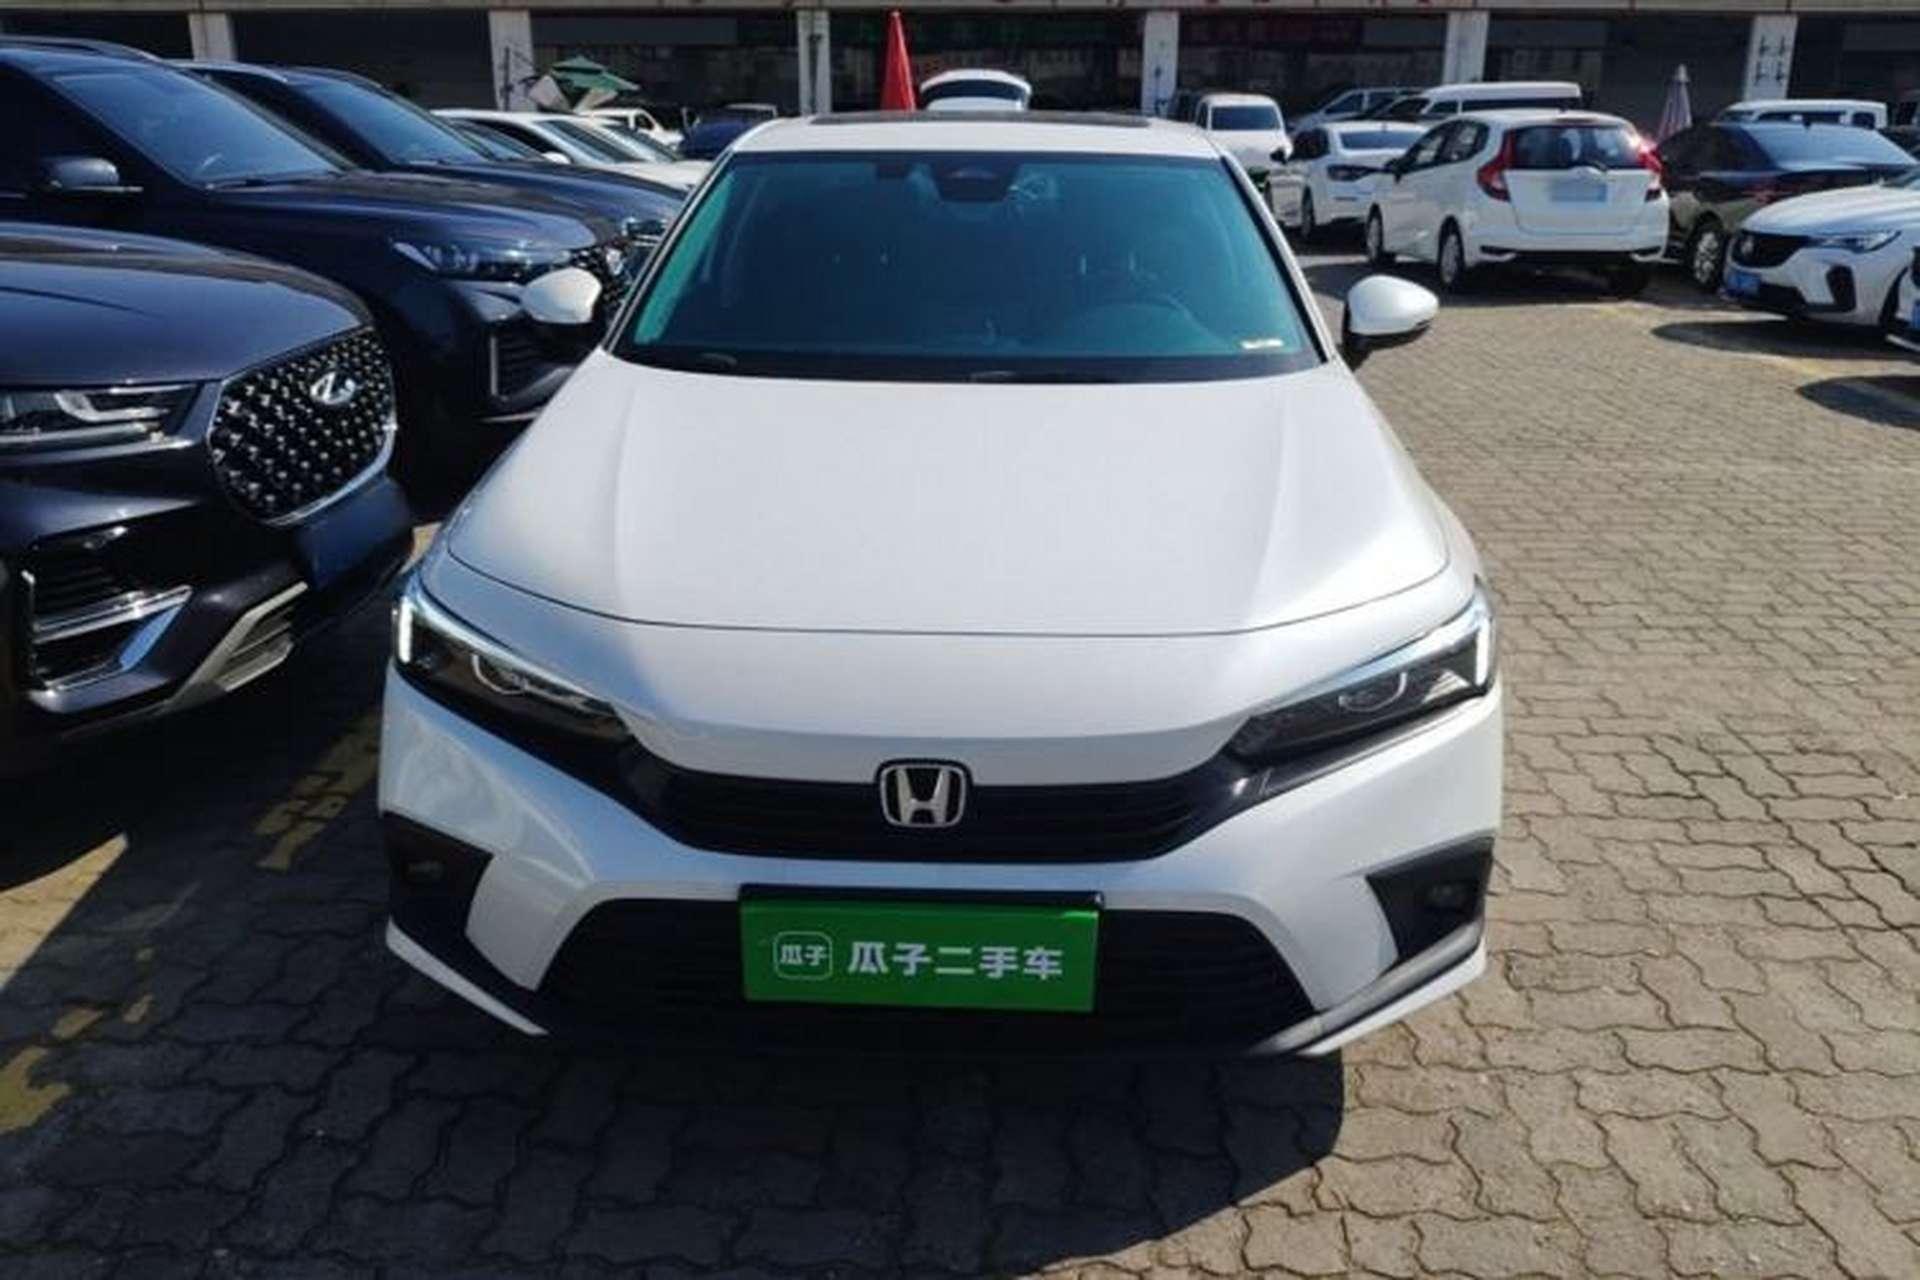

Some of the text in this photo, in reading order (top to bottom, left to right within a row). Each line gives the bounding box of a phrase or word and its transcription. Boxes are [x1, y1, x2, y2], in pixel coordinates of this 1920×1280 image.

[780, 944, 829, 967] 瓜子
[848, 941, 1063, 980] 瓜子二手车
